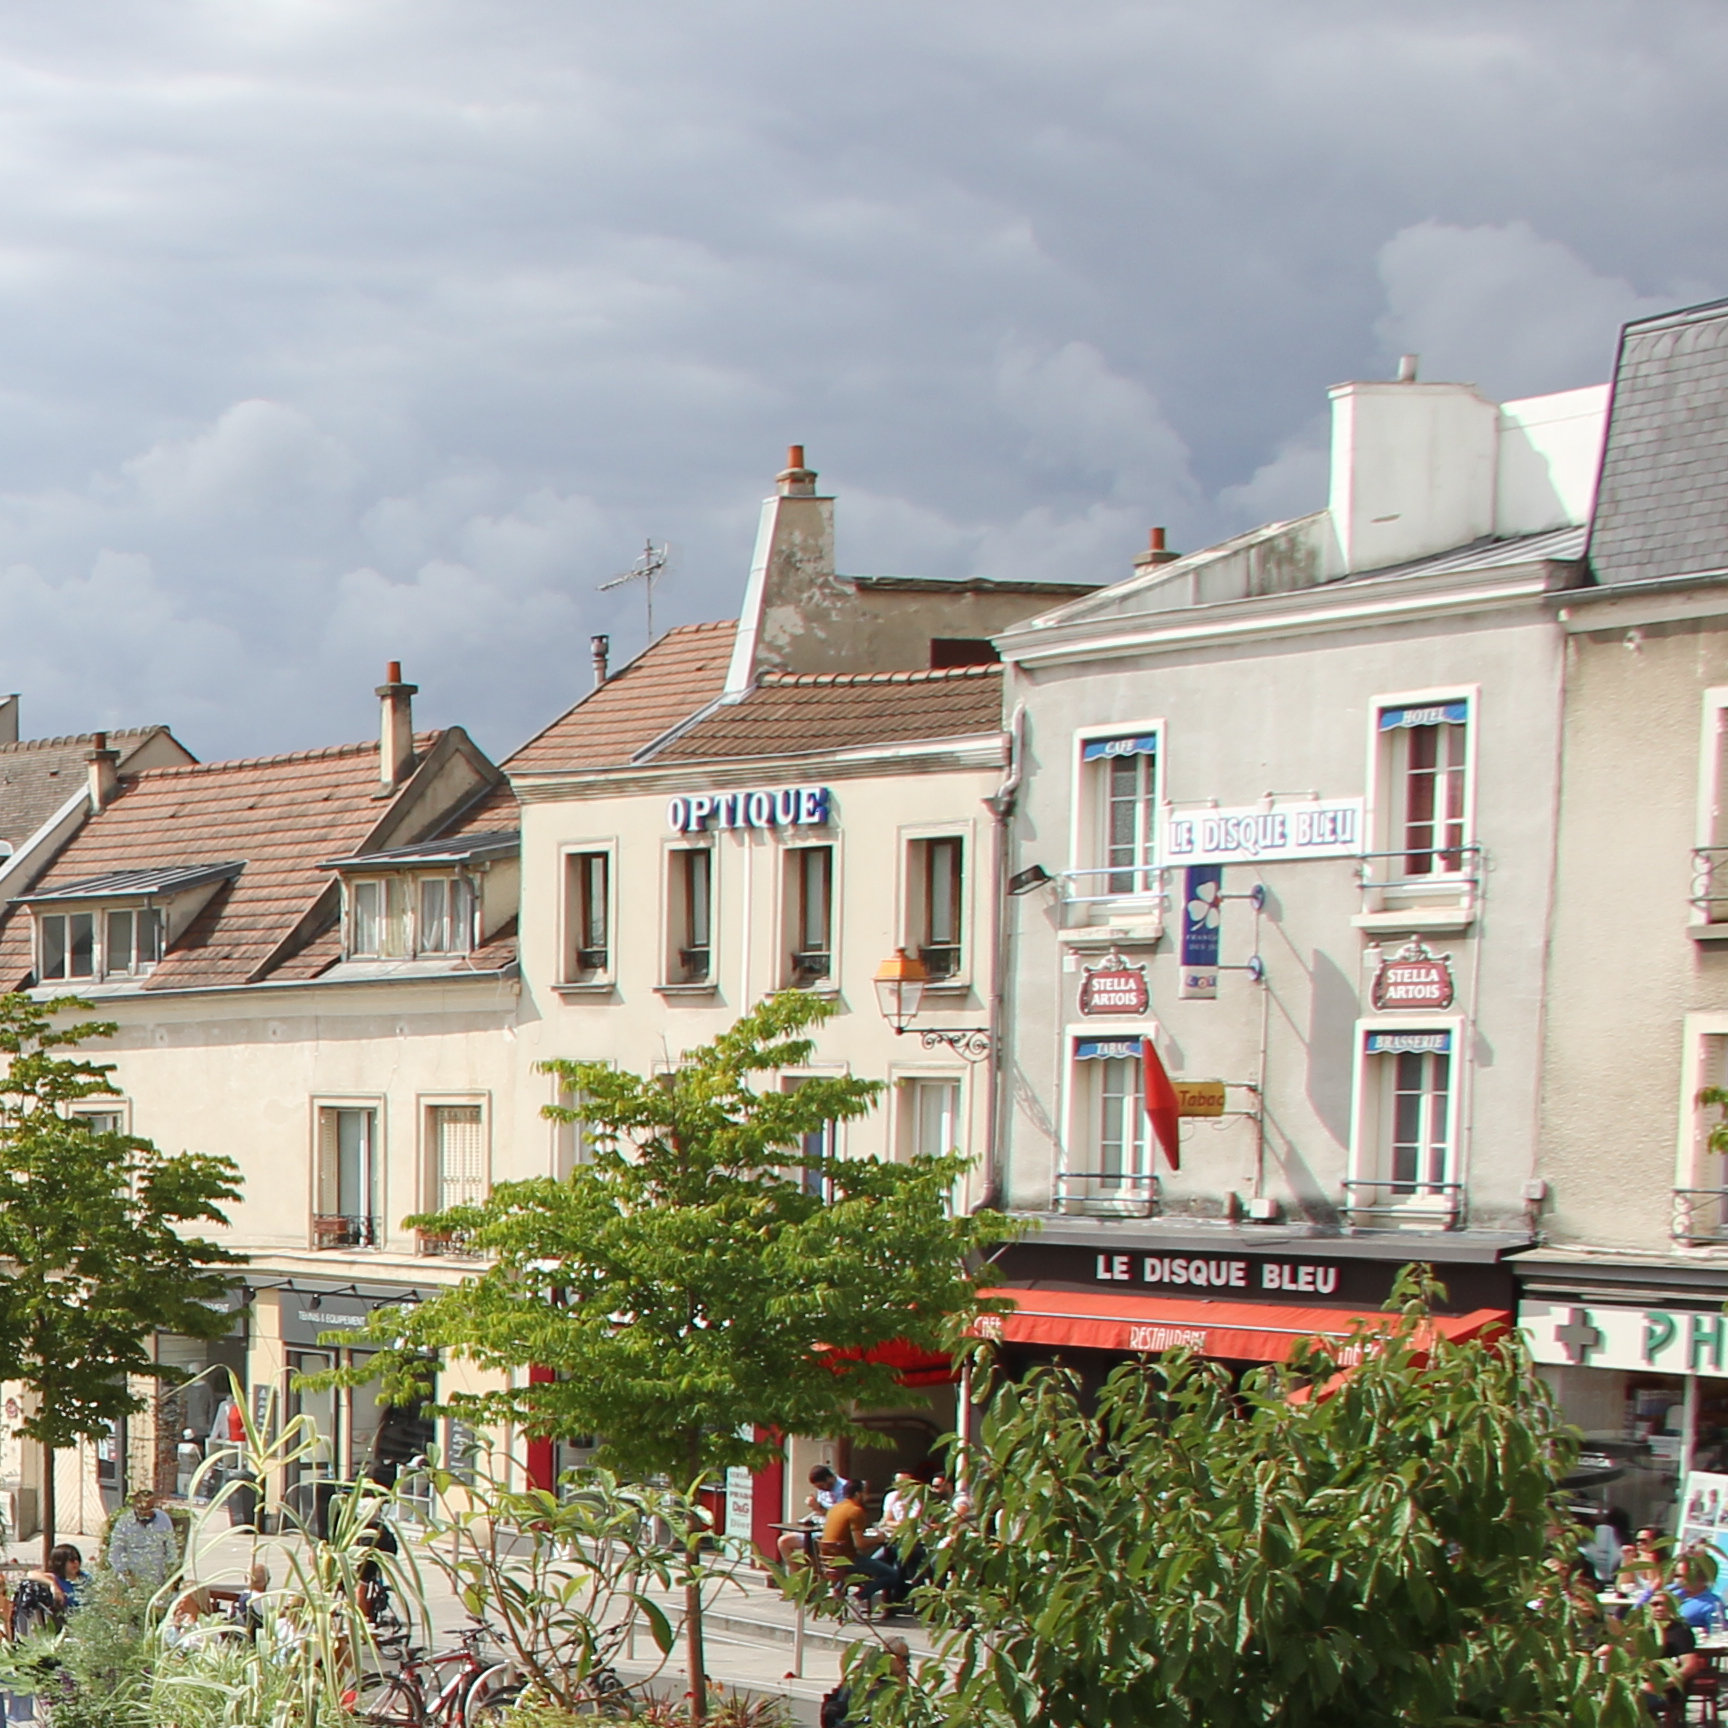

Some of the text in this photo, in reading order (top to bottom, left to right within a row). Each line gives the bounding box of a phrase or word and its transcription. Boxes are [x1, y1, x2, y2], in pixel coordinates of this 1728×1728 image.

[1401, 706, 1445, 725] HOTEL
[667, 787, 829, 832] OPTIQUE
[1168, 807, 1357, 855] LE DISQUE BLEU
[1091, 978, 1137, 990] STELLA
[1387, 968, 1440, 983] STELLA
[1091, 991, 1138, 1006] ARTOIS
[1385, 984, 1440, 999] ARTOIS
[1096, 1042, 1131, 1054] TABAC
[1374, 1034, 1444, 1049] BRASSERIE
[1179, 1090, 1226, 1107] Tabac
[1096, 1254, 1338, 1294] LE DISQUE BLEU
[1129, 1325, 1207, 1352] RESTAURANT
[1642, 1311, 1724, 1371] PH
